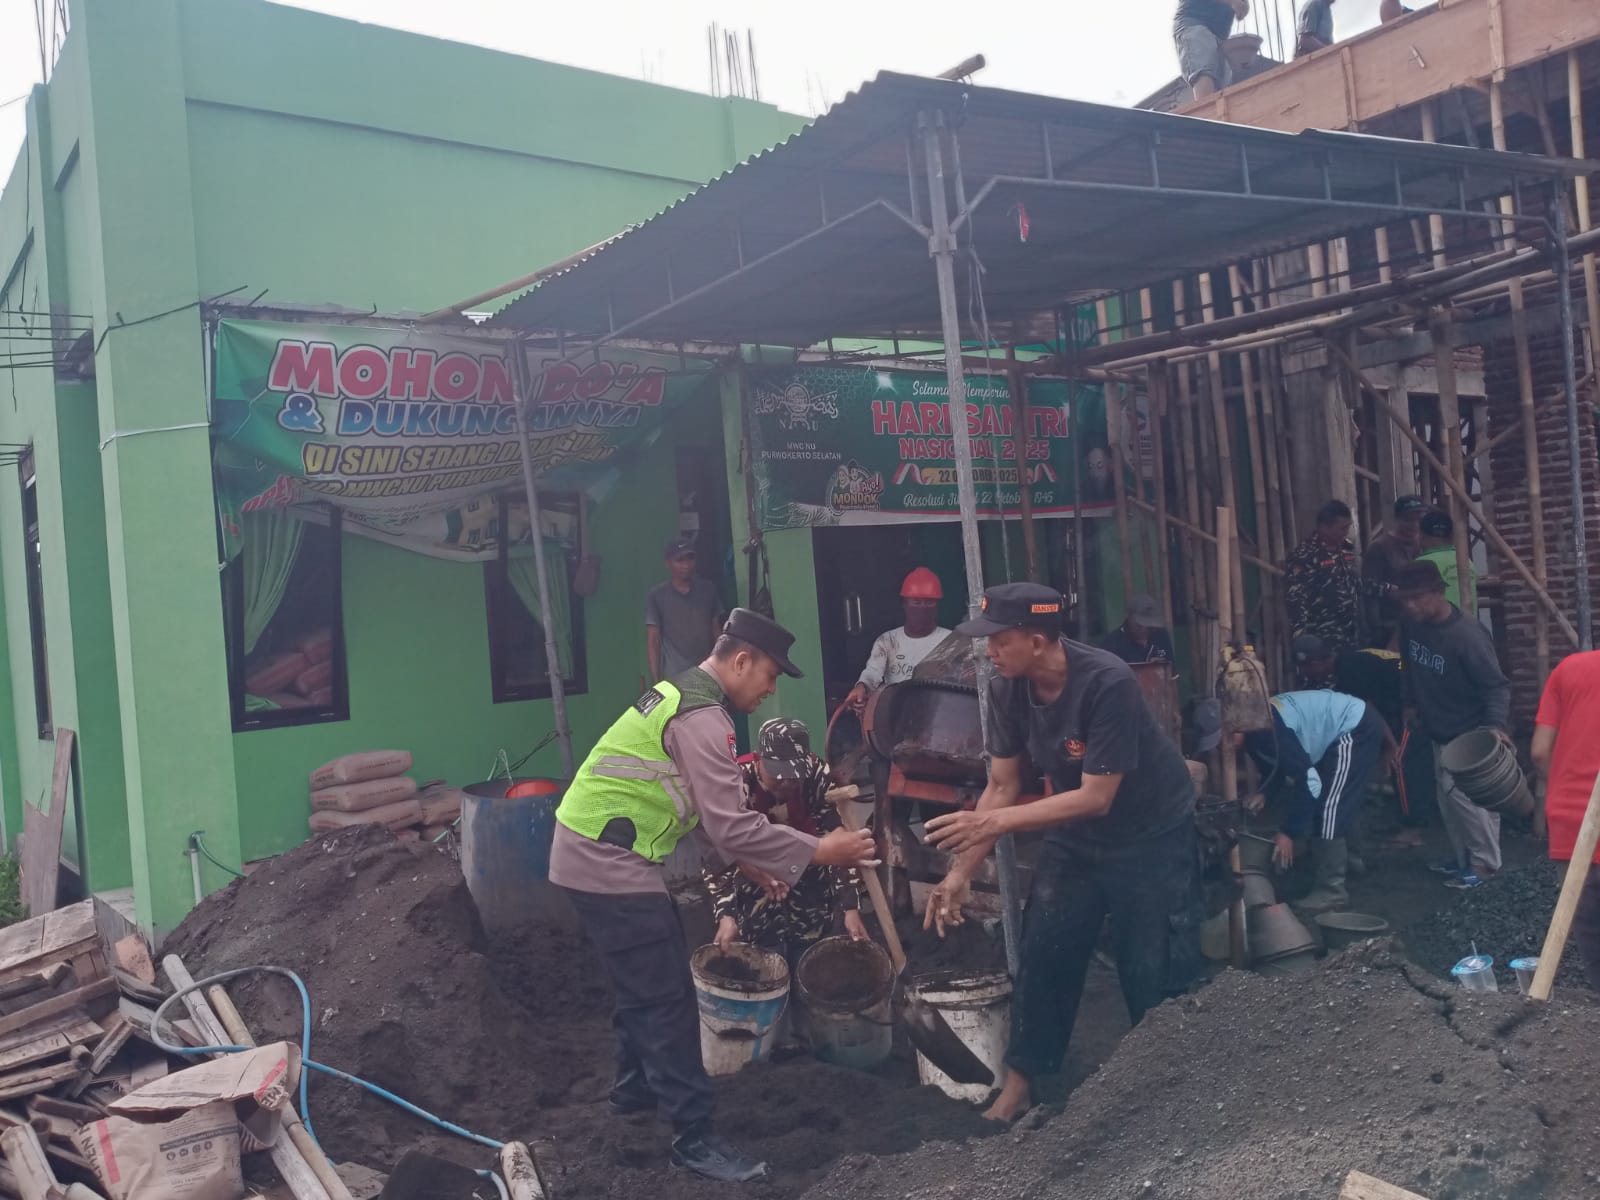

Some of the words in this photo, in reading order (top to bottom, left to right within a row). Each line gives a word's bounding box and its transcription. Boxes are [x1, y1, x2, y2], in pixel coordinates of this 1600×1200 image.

[269, 340, 516, 404] MOHON
[279, 393, 325, 433] &
[871, 400, 952, 436] HARI
[303, 441, 339, 477] DI
[339, 444, 402, 476] SINI
[399, 441, 500, 475] SEDANG
[1000, 439, 1050, 460] 225
[833, 492, 878, 505] MONDOK
